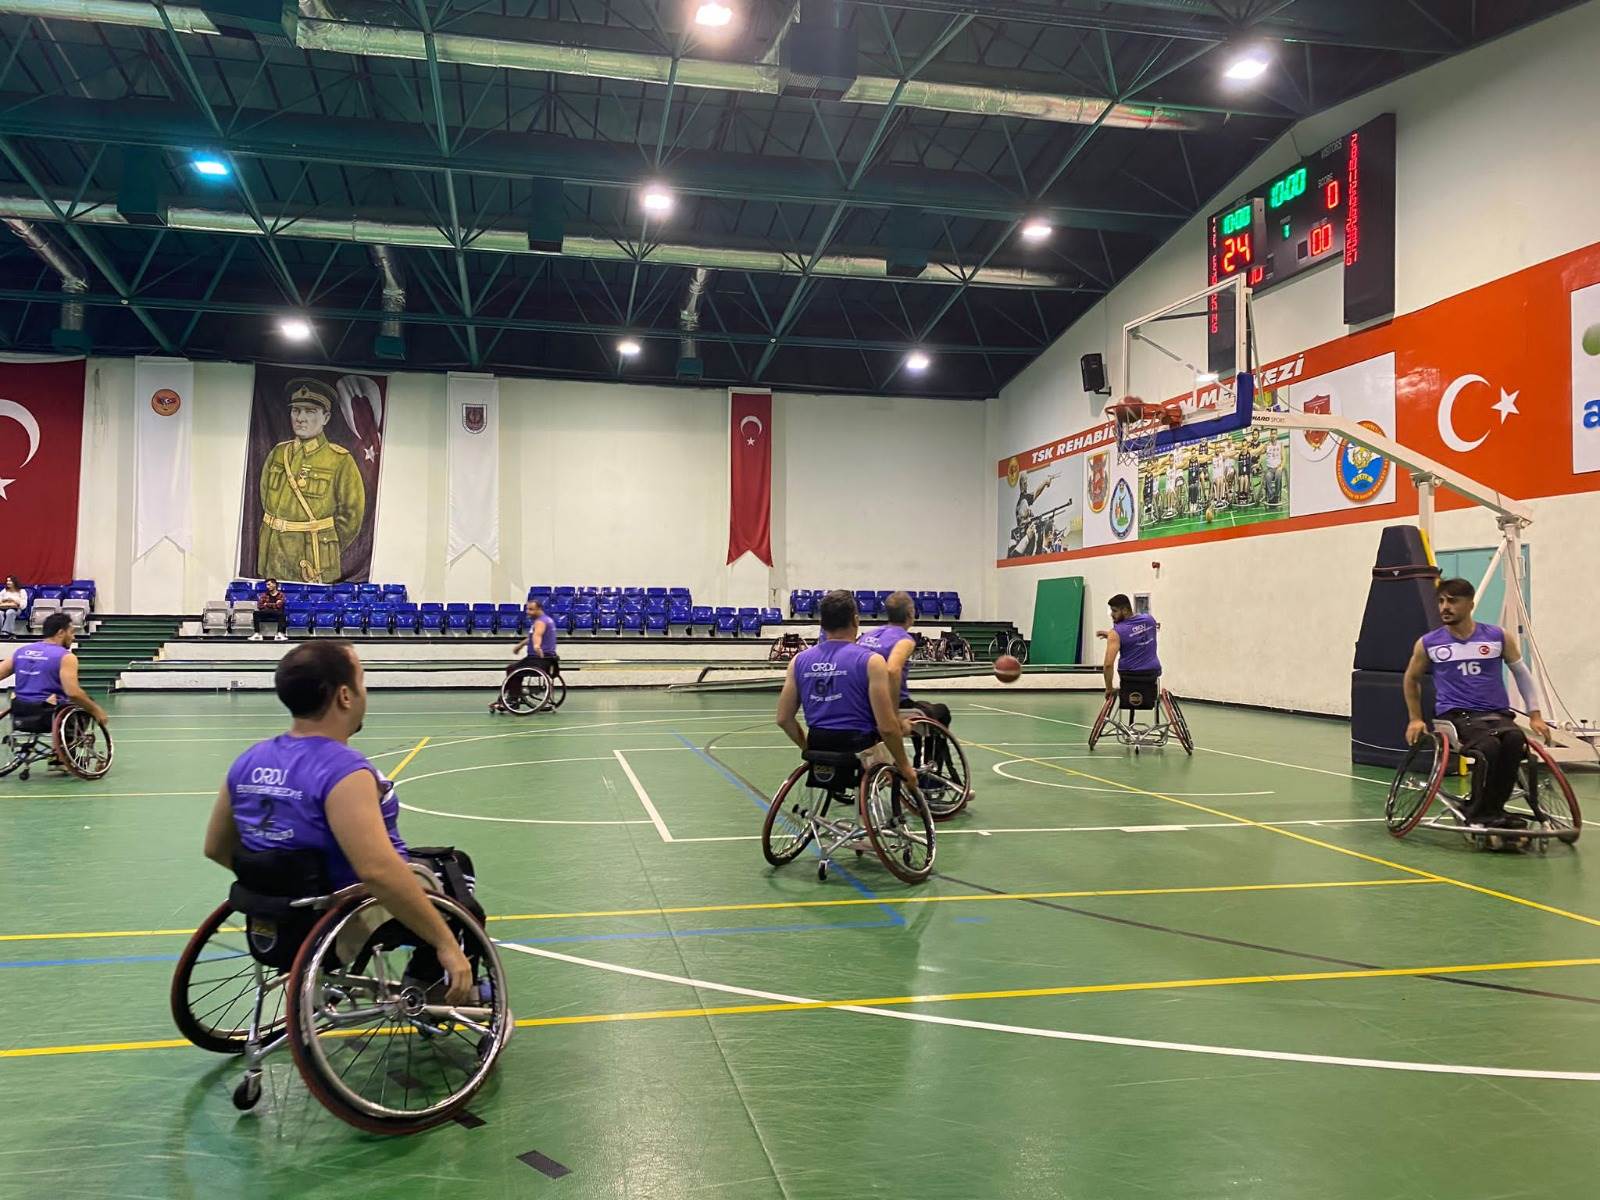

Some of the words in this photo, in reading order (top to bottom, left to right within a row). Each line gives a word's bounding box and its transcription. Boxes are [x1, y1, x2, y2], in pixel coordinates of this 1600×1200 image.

[1327, 181, 1339, 209] 0
[1312, 224, 1332, 256] 00
[1224, 234, 1251, 272] 24
[1031, 446, 1053, 464] TSK
[1457, 661, 1482, 676] 16
[252, 767, 289, 785] ORDU
